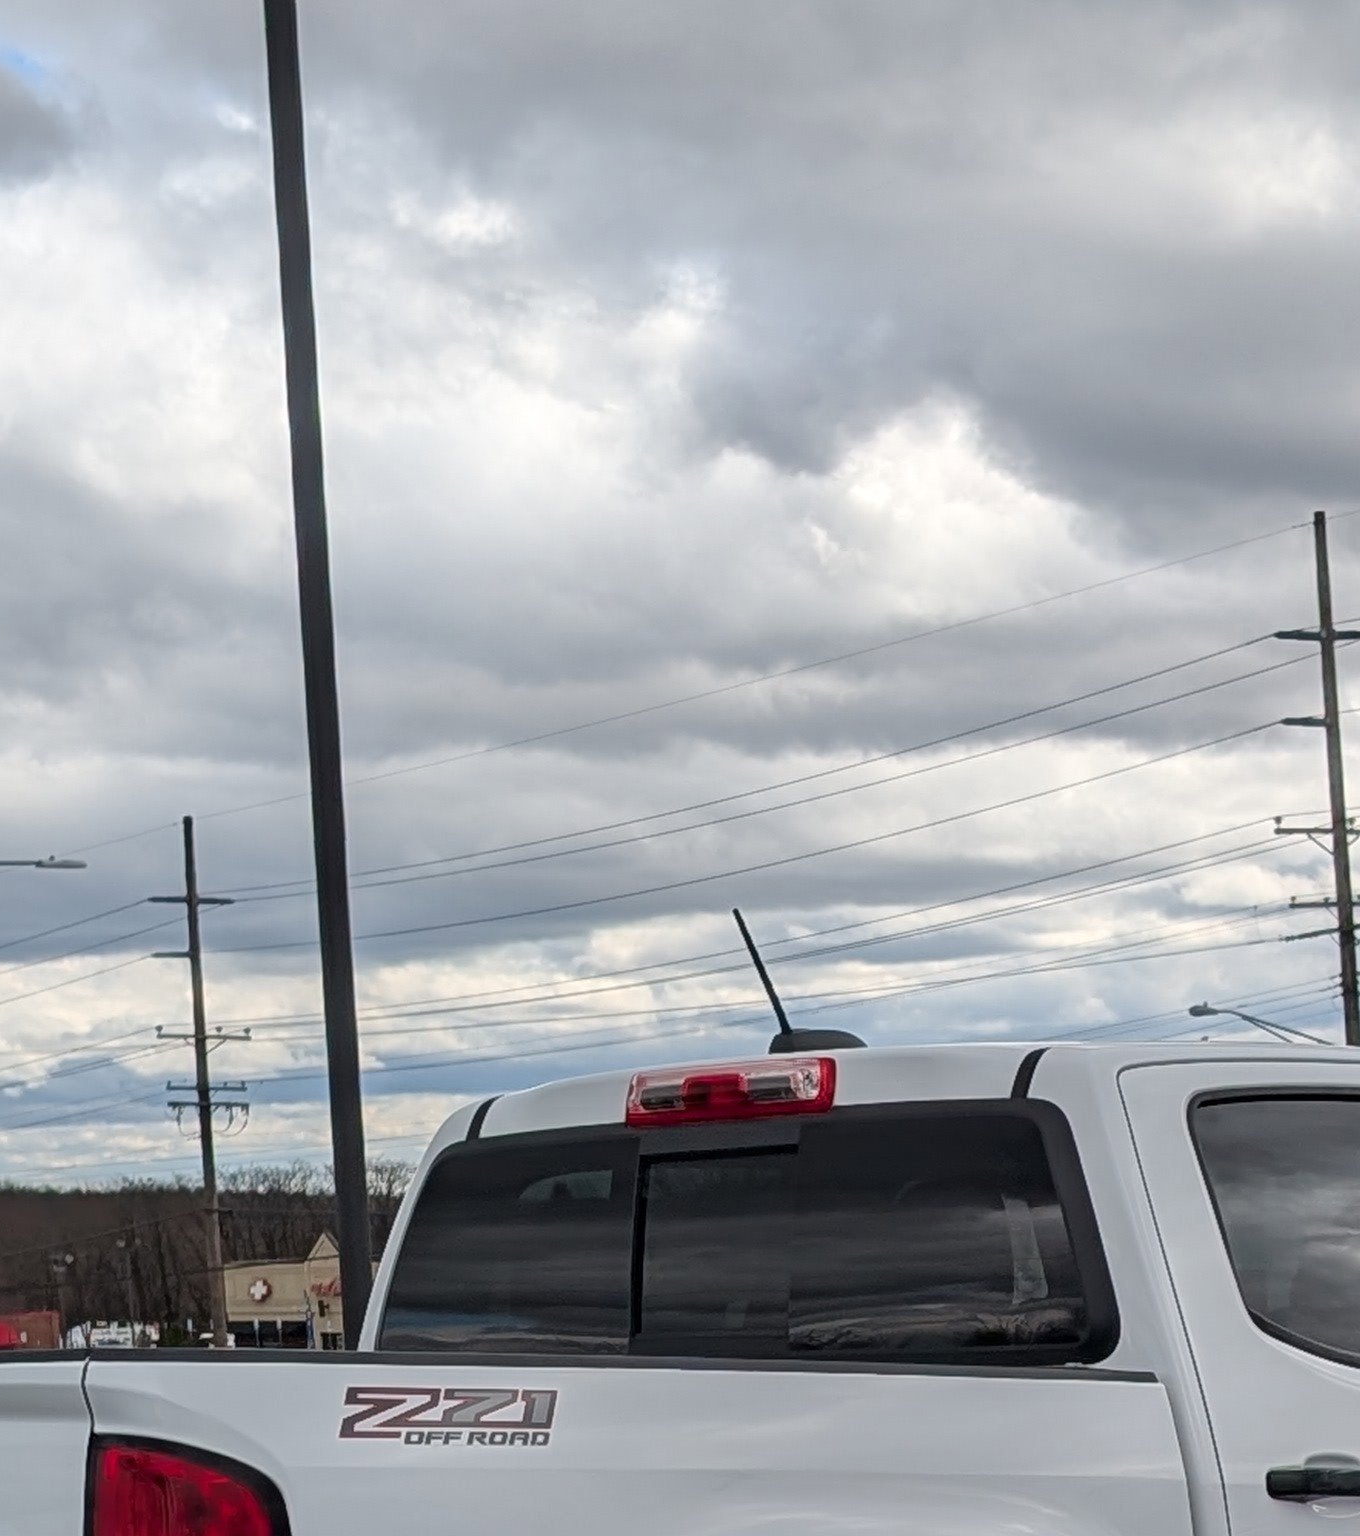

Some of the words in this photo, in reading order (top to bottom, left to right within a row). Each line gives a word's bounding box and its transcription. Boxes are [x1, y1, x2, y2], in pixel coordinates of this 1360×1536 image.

[339, 1386, 558, 1439] Z71
[404, 1431, 462, 1445] OFF
[466, 1431, 551, 1446] ROAD
